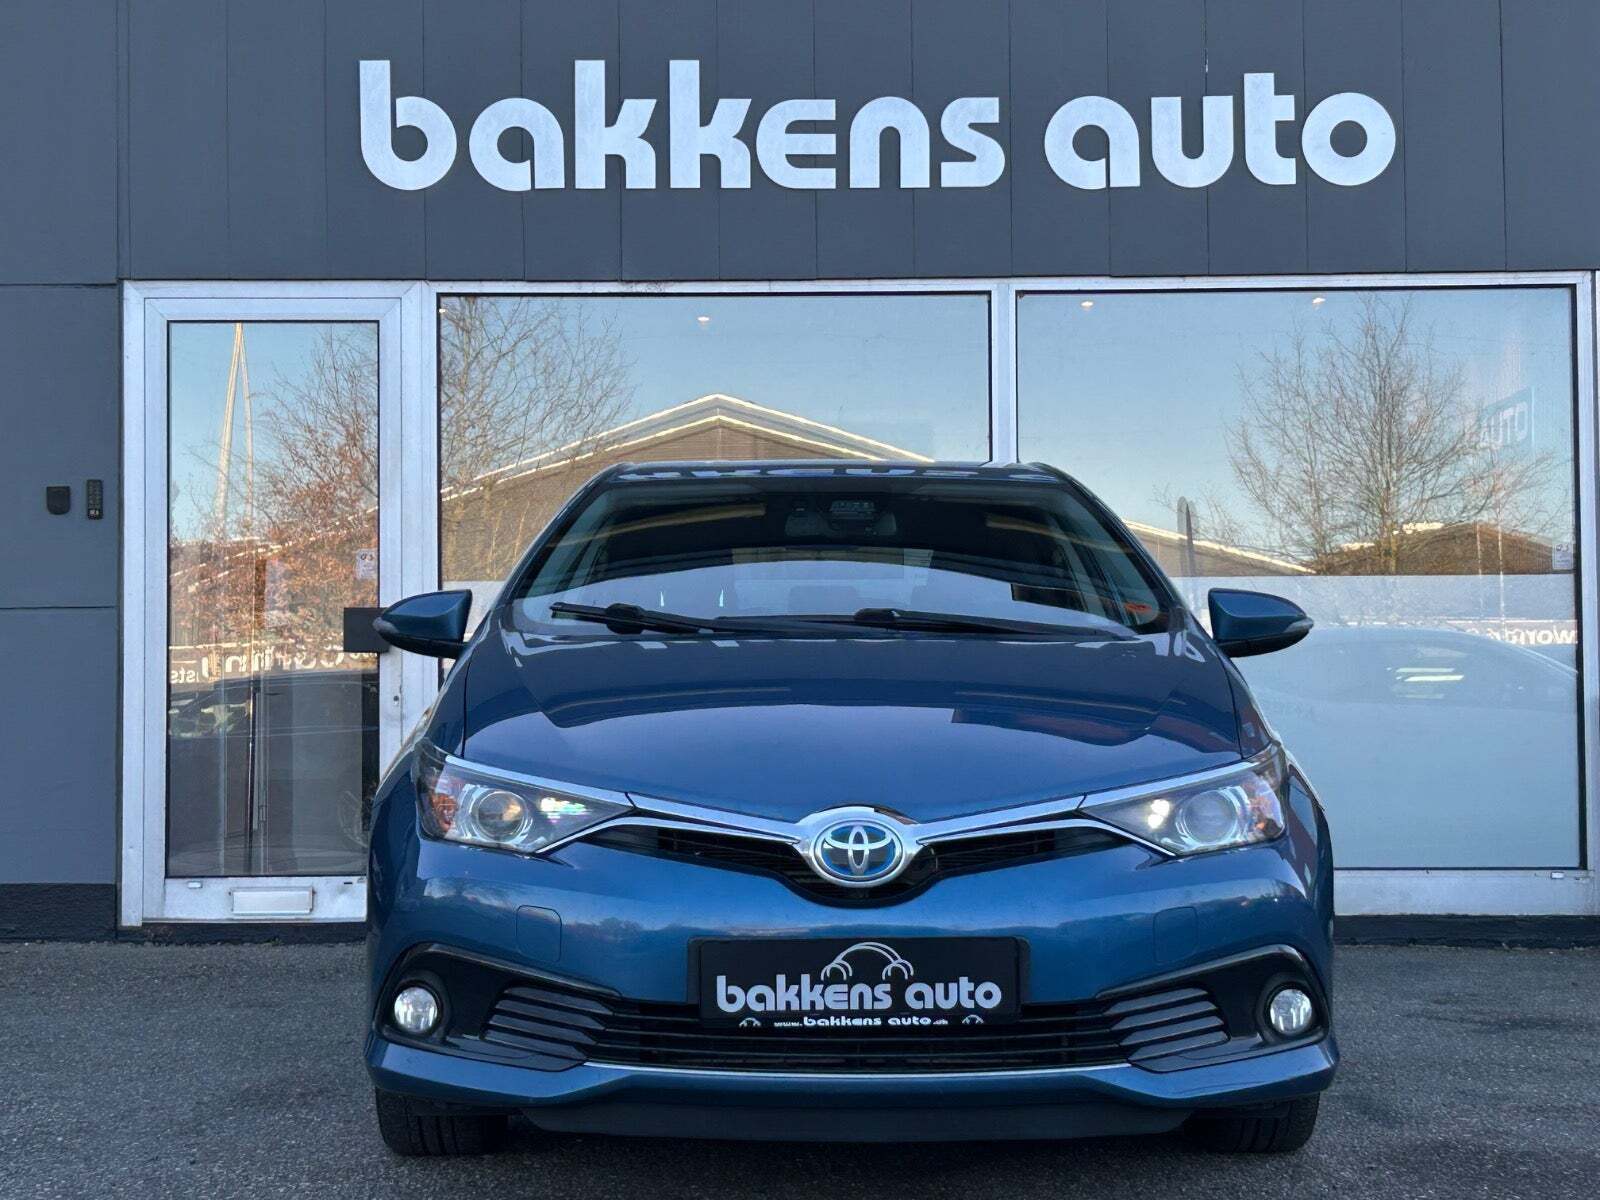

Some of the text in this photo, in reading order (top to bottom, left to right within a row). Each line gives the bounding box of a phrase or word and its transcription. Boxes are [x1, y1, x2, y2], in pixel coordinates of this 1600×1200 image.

[360, 60, 1396, 191] bakkens auto
[717, 974, 1002, 1012] bakkens auto
